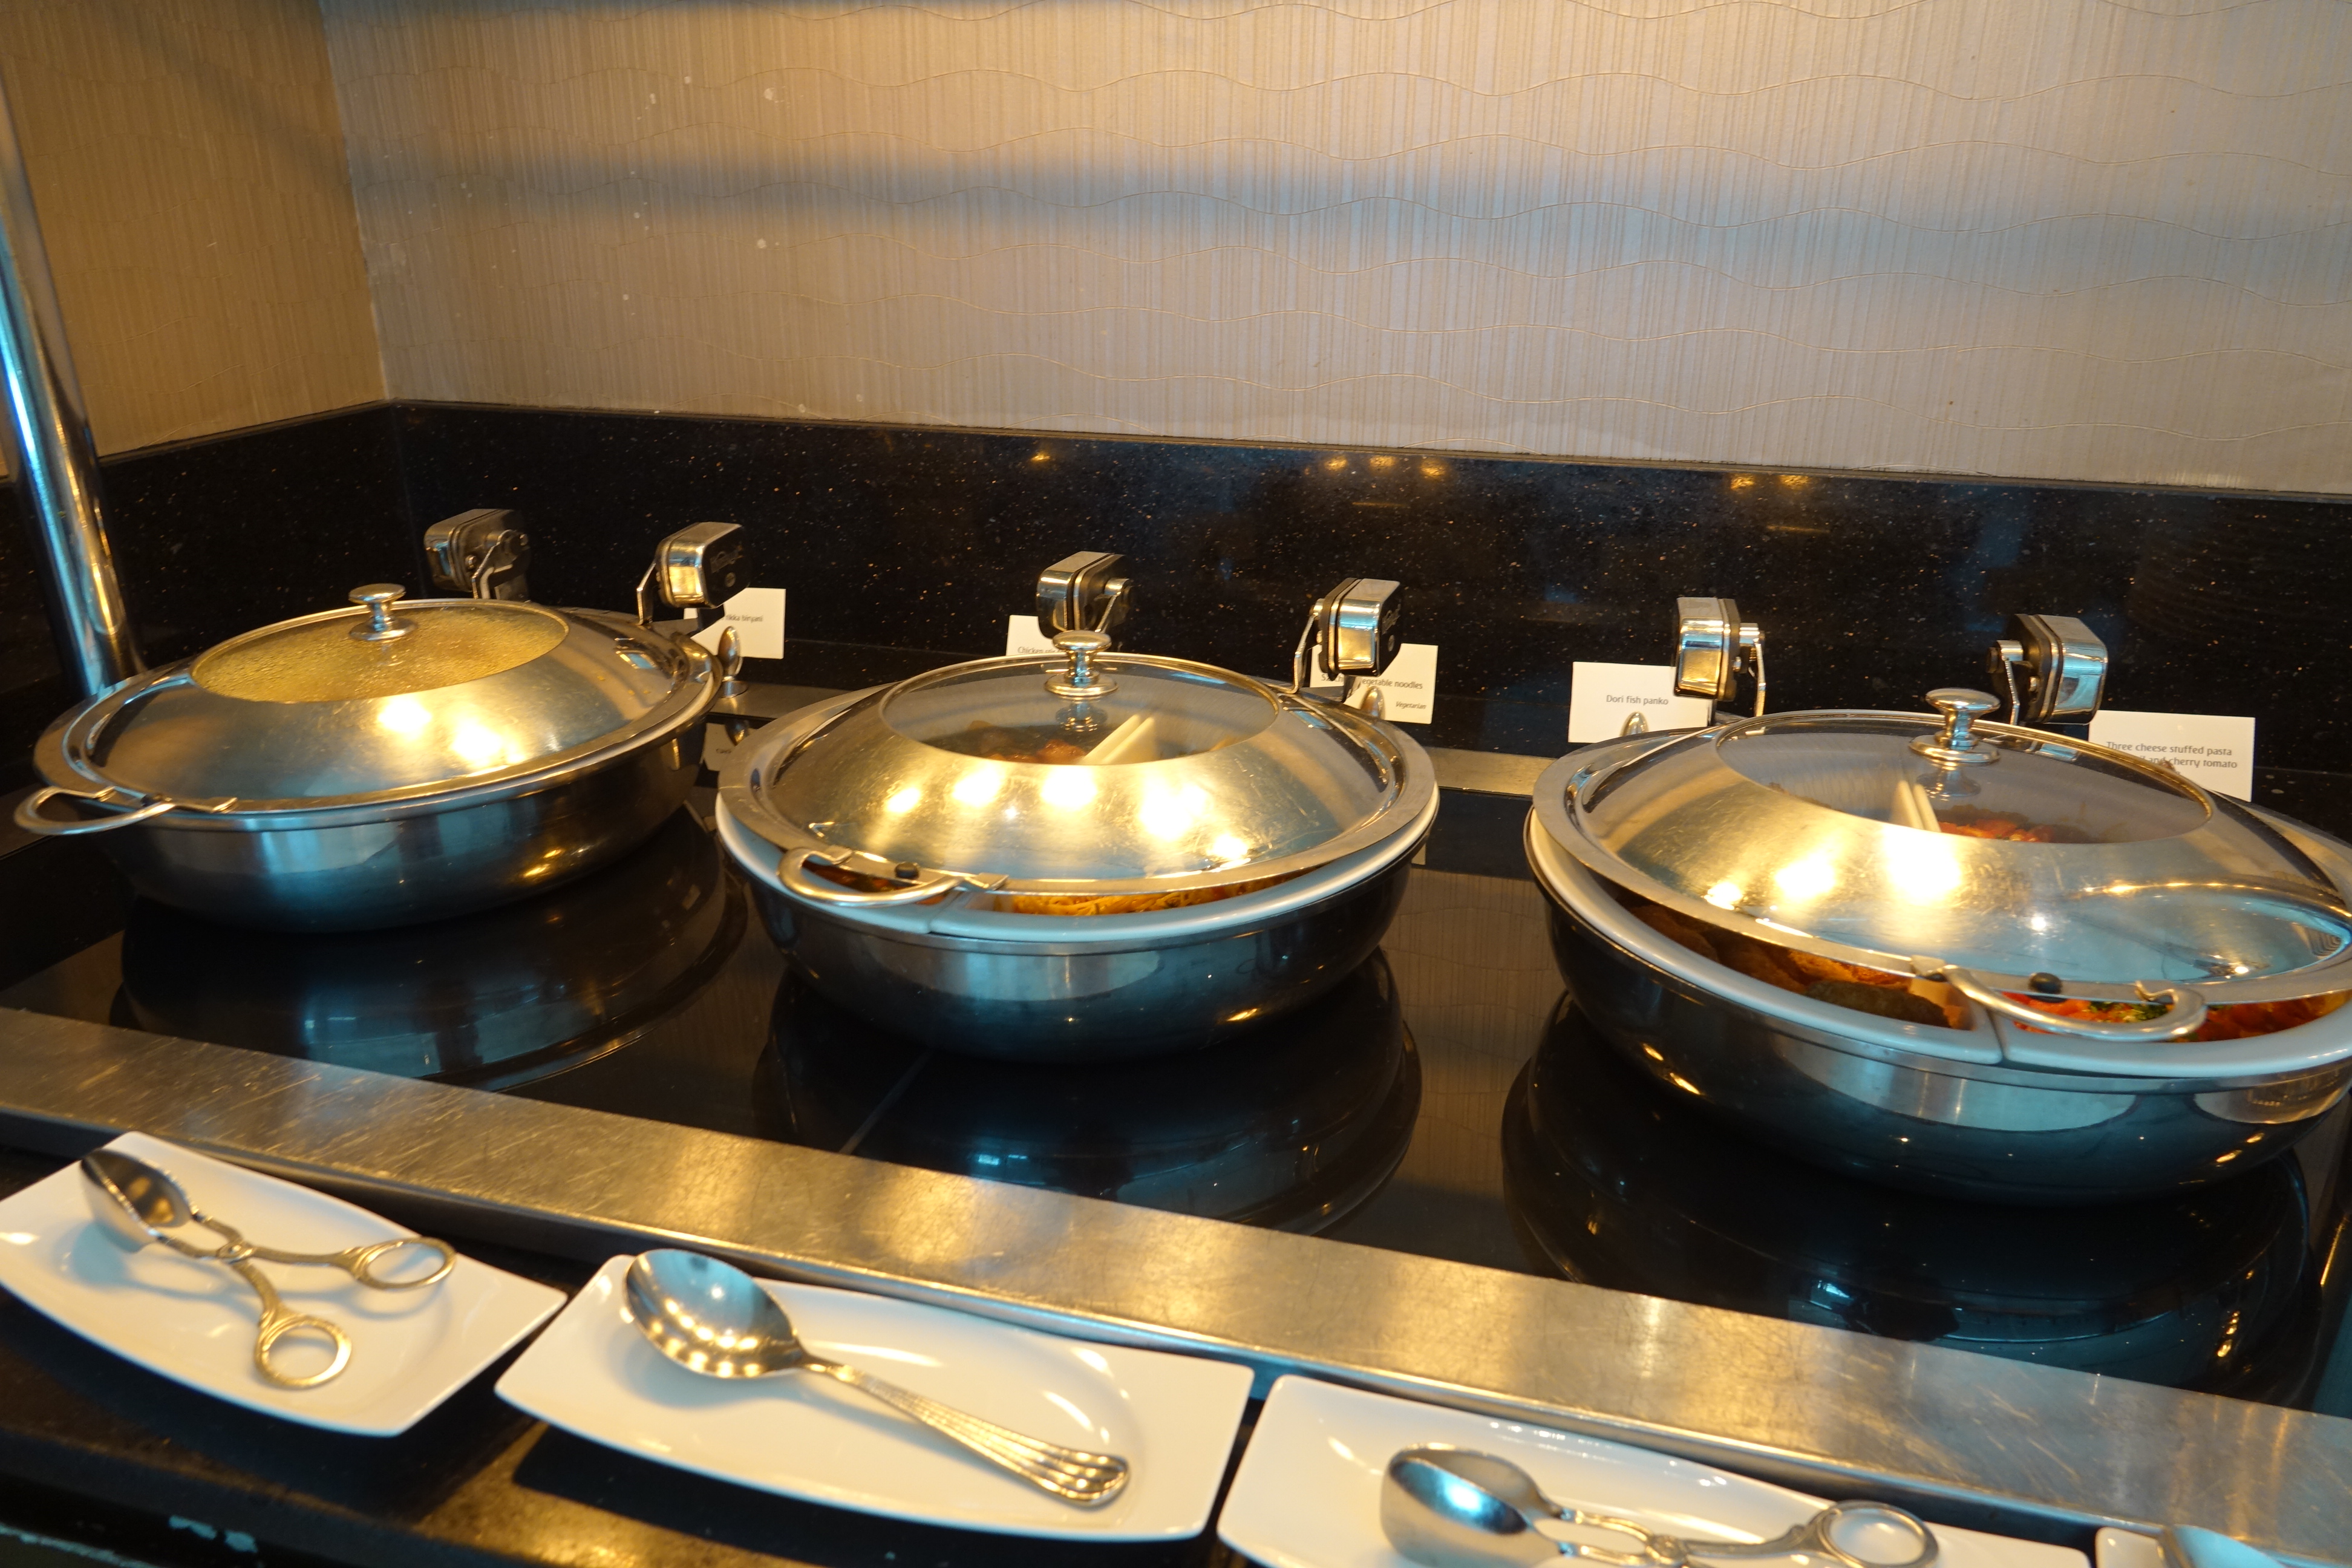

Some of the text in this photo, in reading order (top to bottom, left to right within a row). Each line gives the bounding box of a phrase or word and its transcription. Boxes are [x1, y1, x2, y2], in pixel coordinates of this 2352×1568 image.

[742, 615, 763, 623] biryani
[1362, 678, 1423, 690] egetable noodles
[1396, 701, 1427, 710] Vegetarian
[1606, 694, 1669, 706] Dori fish panko
[2106, 741, 2232, 756] Three cheese stuffed pasta
[2169, 757, 2201, 768] cherry
[2203, 759, 2238, 768] tomato
